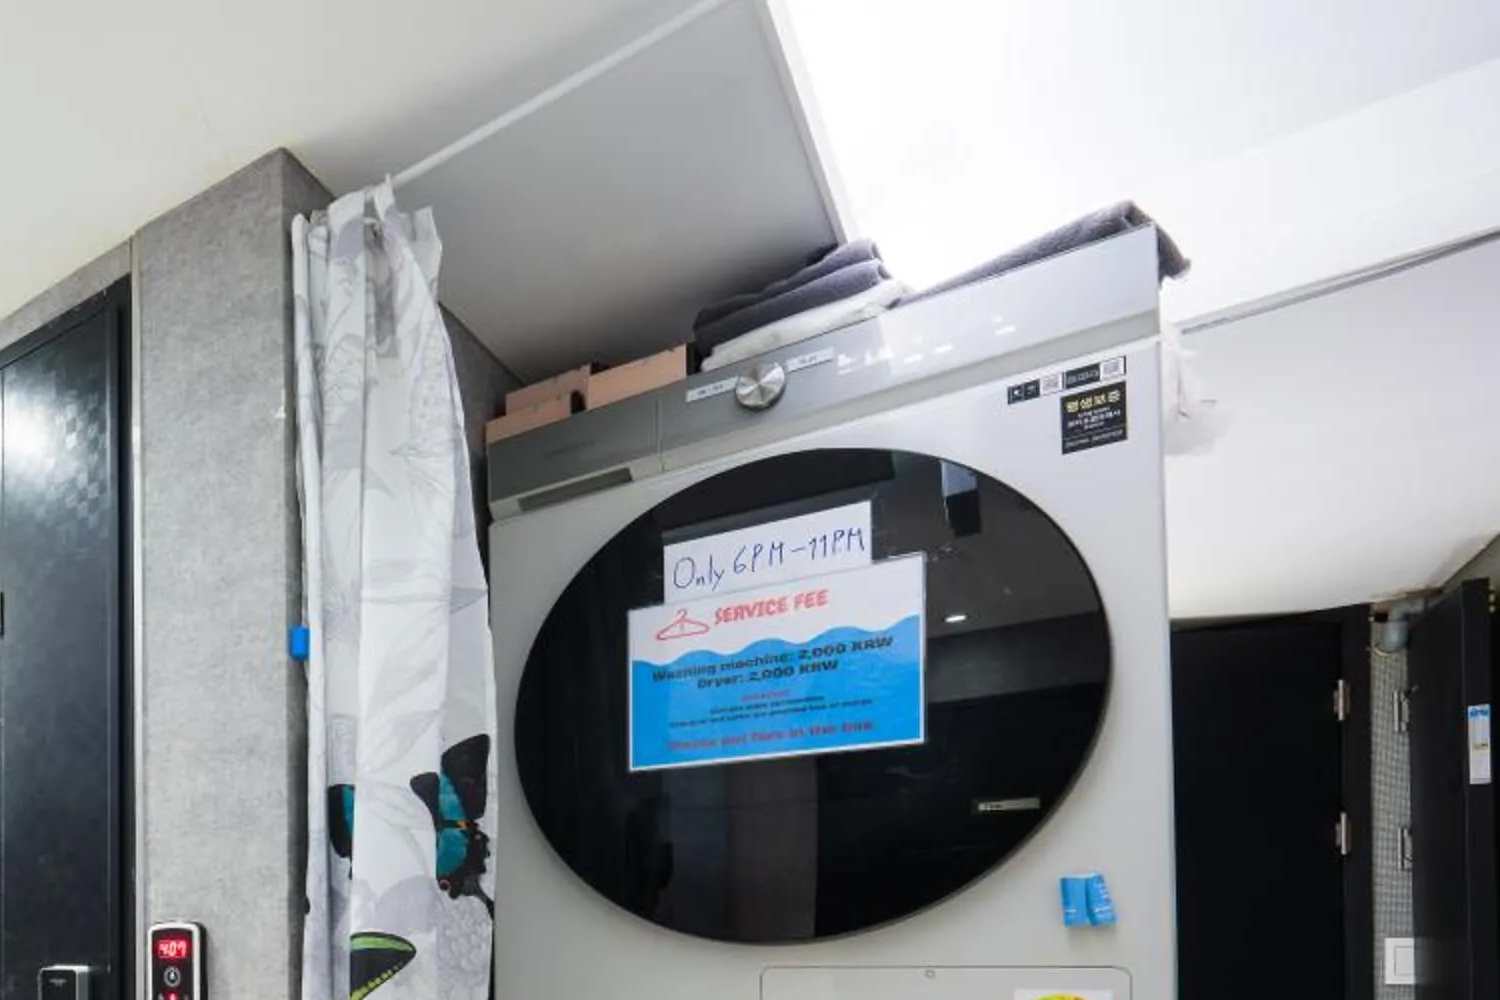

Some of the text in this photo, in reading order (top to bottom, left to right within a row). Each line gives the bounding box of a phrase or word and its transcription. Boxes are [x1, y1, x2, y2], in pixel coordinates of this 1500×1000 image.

[673, 554, 725, 591] Only
[715, 589, 830, 625] SERVICE FEE
[652, 661, 716, 682] Washing
[798, 643, 847, 660] 2,000
[851, 636, 894, 652] KRW
[697, 659, 839, 690] Dryer: 2,000 KRW
